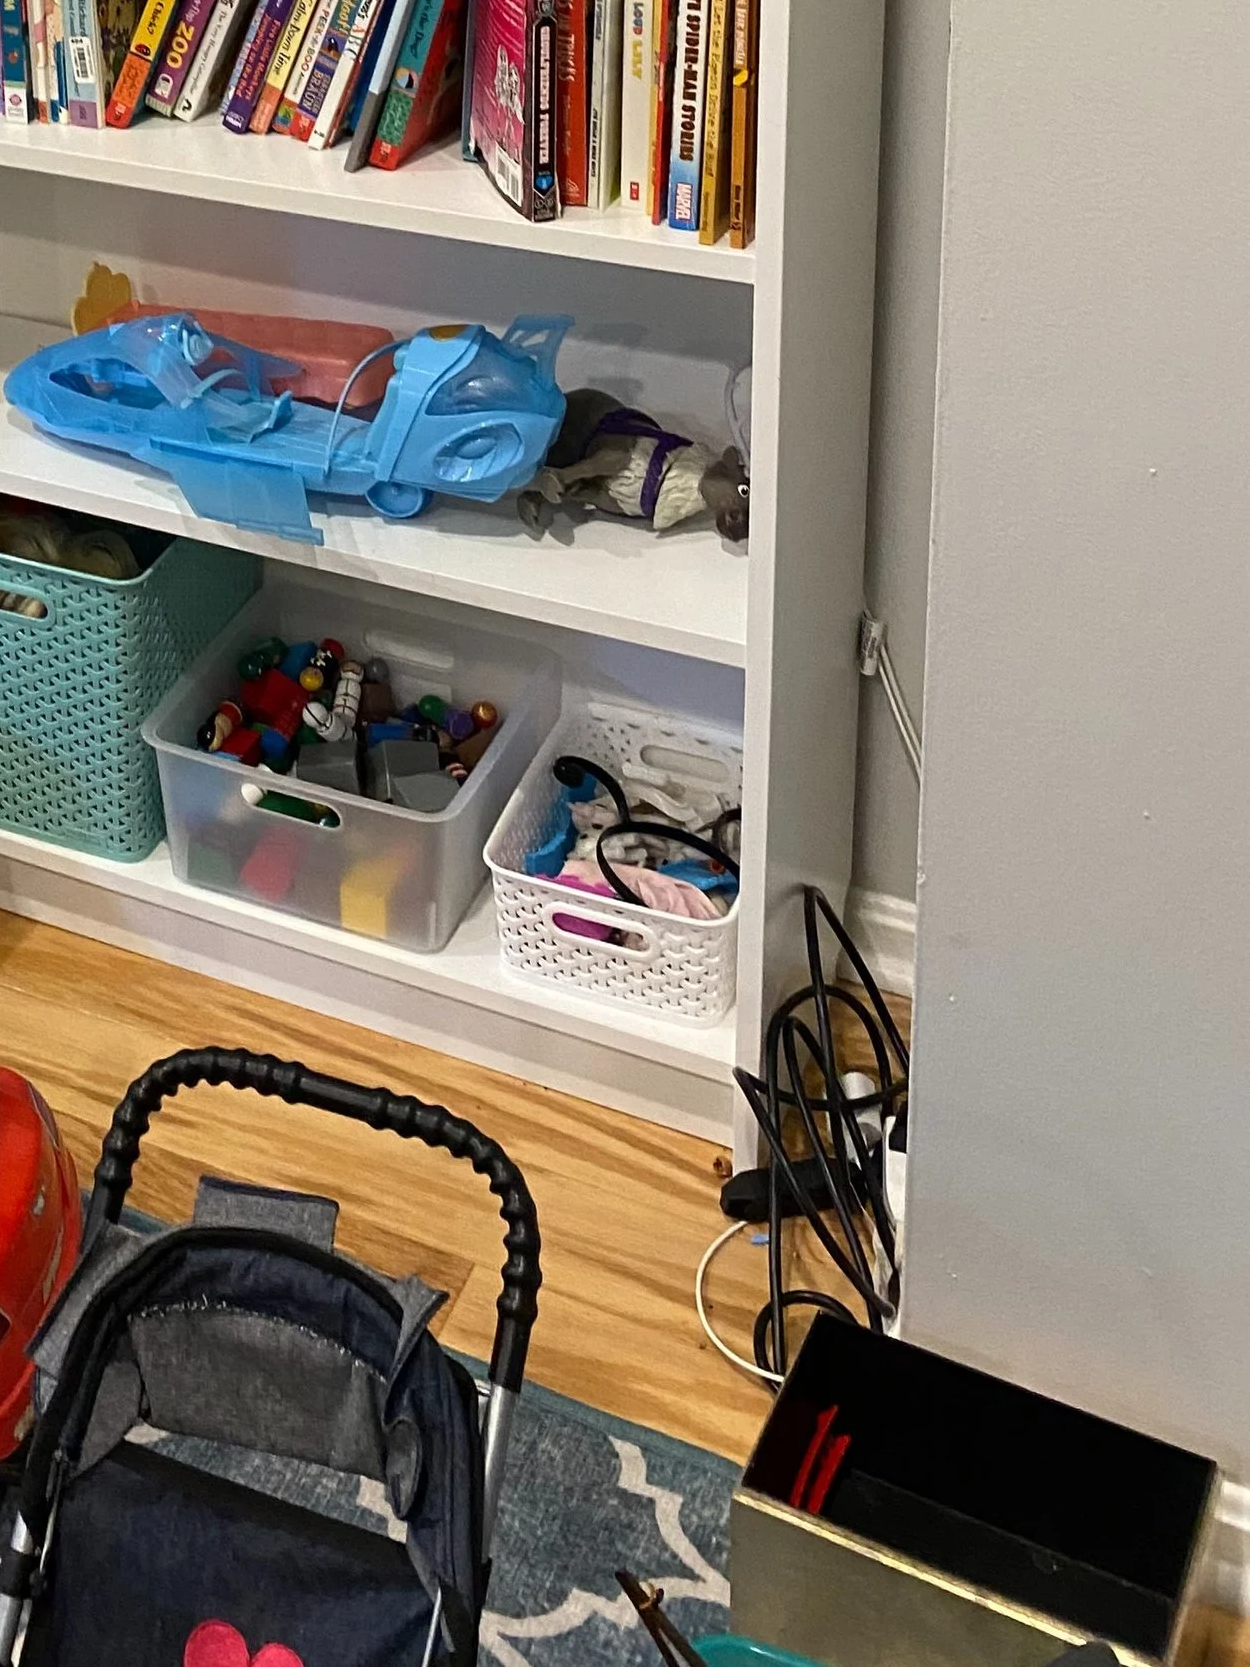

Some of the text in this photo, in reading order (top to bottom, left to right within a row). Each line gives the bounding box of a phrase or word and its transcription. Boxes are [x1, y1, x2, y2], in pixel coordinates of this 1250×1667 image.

[145, 0, 165, 35] Chick?
[416, 12, 431, 32] the
[632, 1, 643, 35] LOUD
[713, 6, 723, 25] Let
[163, 19, 196, 70] ZOO
[187, 10, 227, 95] The Very Hungry Caterpillar
[233, 12, 272, 96] Jumping on the Bed
[556, 33, 577, 82] TRUCKS
[682, 13, 701, 100] SPIDER-MAN
[712, 29, 721, 47] the
[241, 18, 281, 100] Five Little Monkeys
[272, 51, 292, 77] Time
[631, 40, 642, 79] LILY
[708, 52, 720, 88] Pigeon
[300, 68, 324, 110] BRAUN
[707, 93, 717, 124] Drive
[679, 104, 697, 162] STORIES
[706, 130, 715, 148] the
[675, 182, 692, 222] MARVEL
